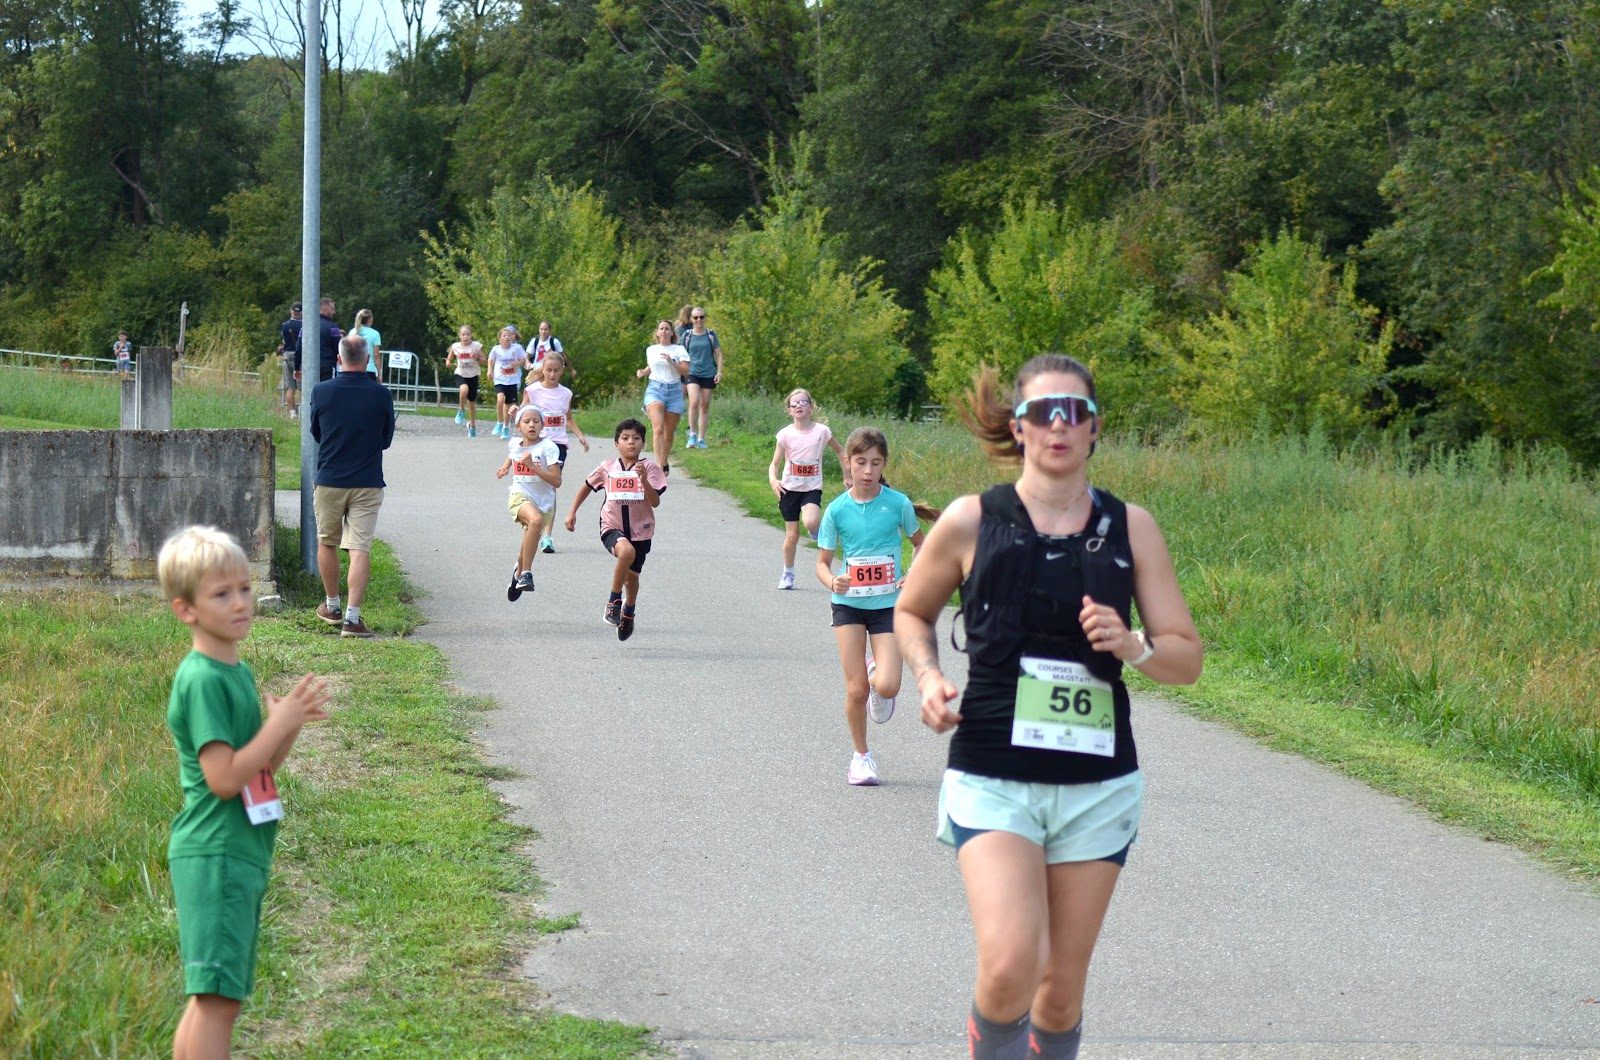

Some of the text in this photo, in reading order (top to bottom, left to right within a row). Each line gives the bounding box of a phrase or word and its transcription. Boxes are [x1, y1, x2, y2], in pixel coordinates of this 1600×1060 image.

[797, 466, 813, 474] 682
[616, 479, 634, 489] 629
[857, 567, 882, 582] 615
[1037, 664, 1073, 674] COURSES
[1049, 686, 1092, 716] 56
